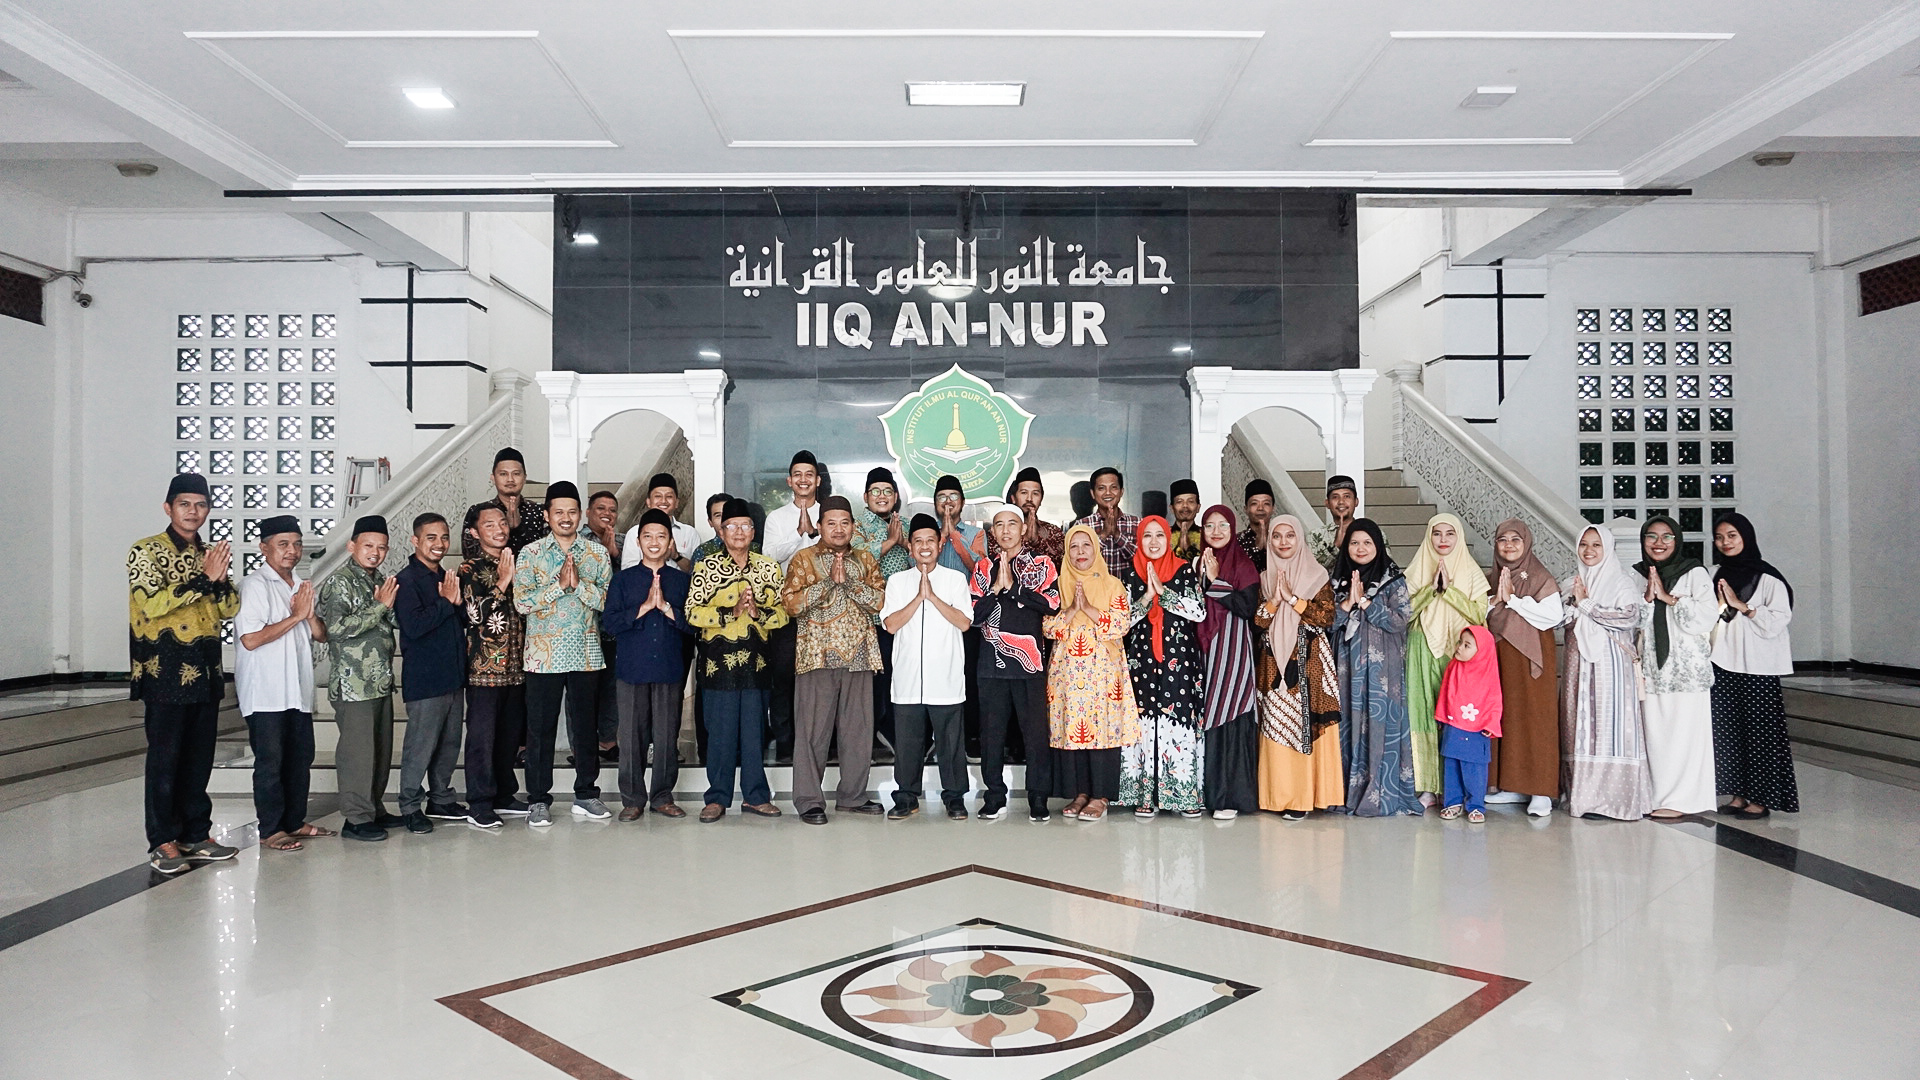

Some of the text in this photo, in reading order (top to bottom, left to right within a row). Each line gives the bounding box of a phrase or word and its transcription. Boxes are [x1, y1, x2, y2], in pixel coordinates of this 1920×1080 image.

[865, 235, 978, 295] للعلوم
[981, 235, 1061, 294] النور
[1066, 235, 1176, 295] جامعة
[796, 301, 1109, 350] IIQ AN-NUR
[906, 390, 1007, 444] INSTITUT ILMU AL QUR'AN AN NUR
